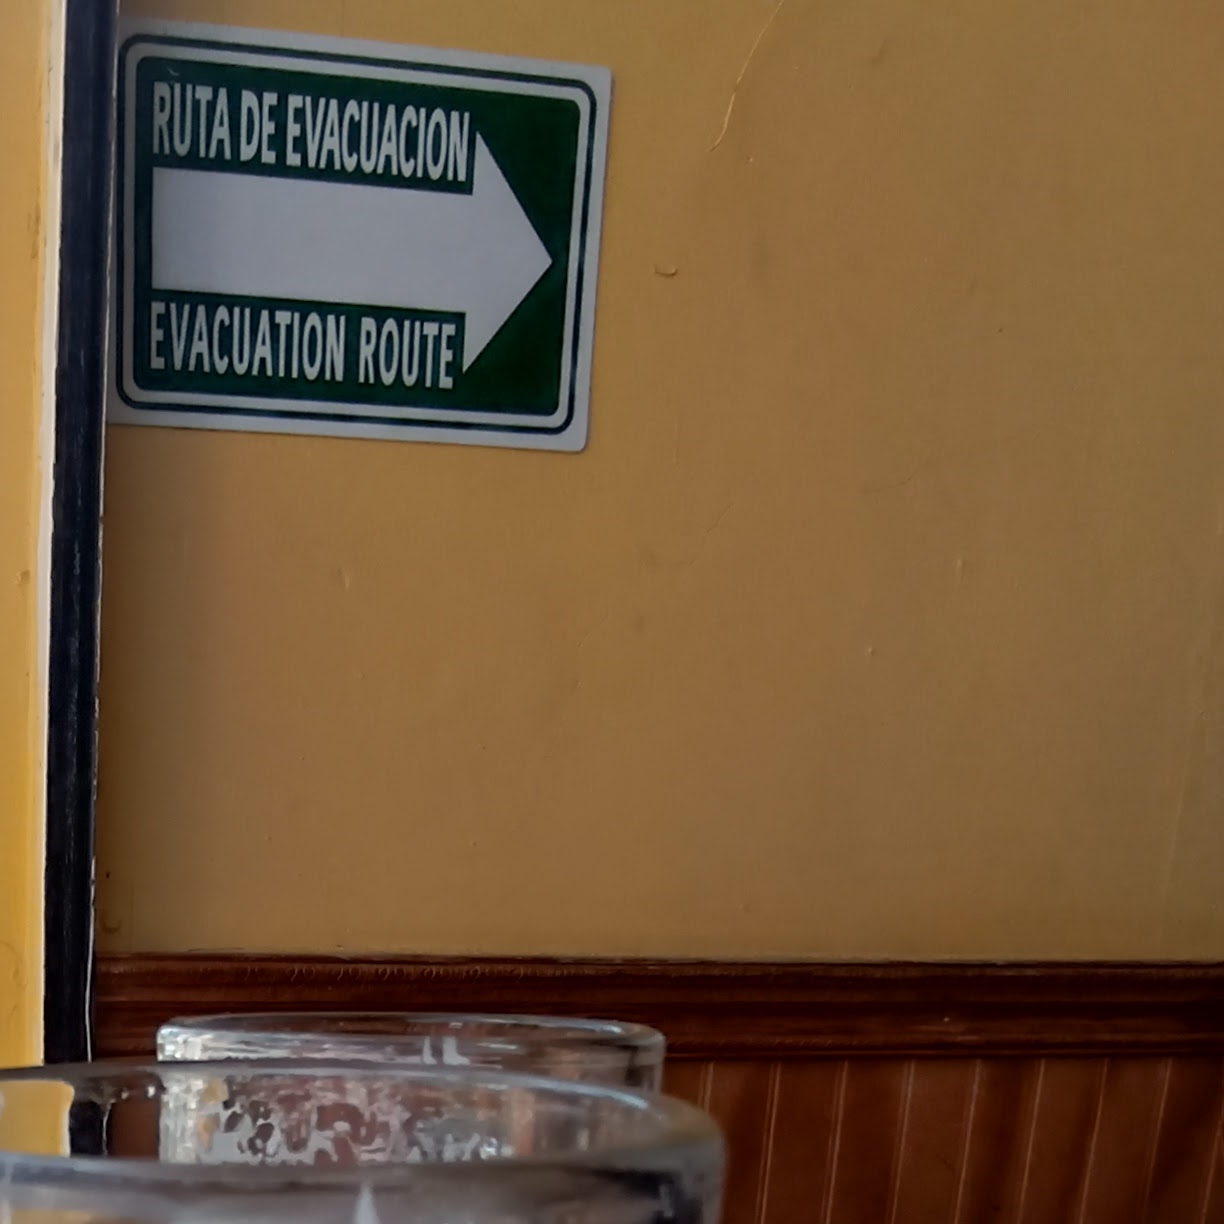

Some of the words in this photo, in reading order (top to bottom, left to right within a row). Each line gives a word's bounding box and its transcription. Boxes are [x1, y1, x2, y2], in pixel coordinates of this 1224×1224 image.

[152, 80, 232, 162] RUTA
[239, 90, 278, 165] DE
[285, 93, 471, 183] EVACUACION
[149, 301, 347, 383] EVACUATION
[357, 317, 457, 390] ROUTE
